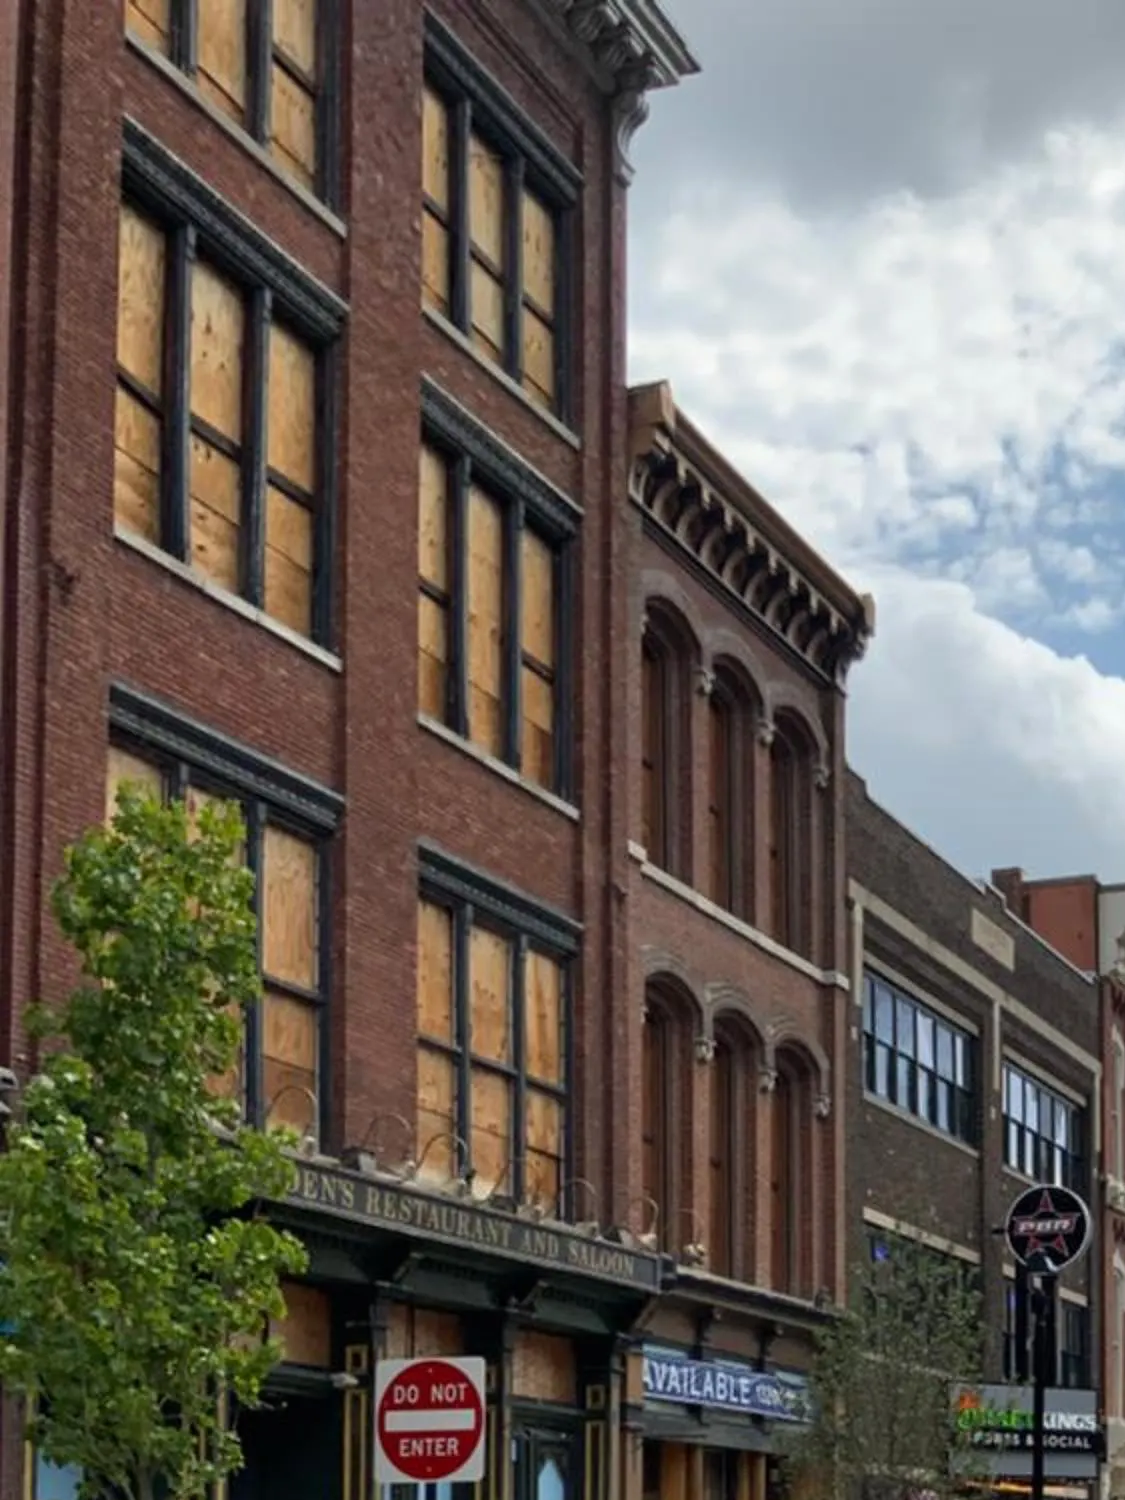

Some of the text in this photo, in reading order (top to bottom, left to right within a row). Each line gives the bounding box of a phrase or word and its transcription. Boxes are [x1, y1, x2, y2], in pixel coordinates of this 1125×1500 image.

[366, 1186, 511, 1248] RESTAURANT
[521, 1228, 559, 1259] AND
[568, 1240, 634, 1277] SALOON
[393, 1382, 468, 1405] DO NOT
[643, 1357, 750, 1405] AVAILABLE
[399, 1437, 459, 1457] ENTER
